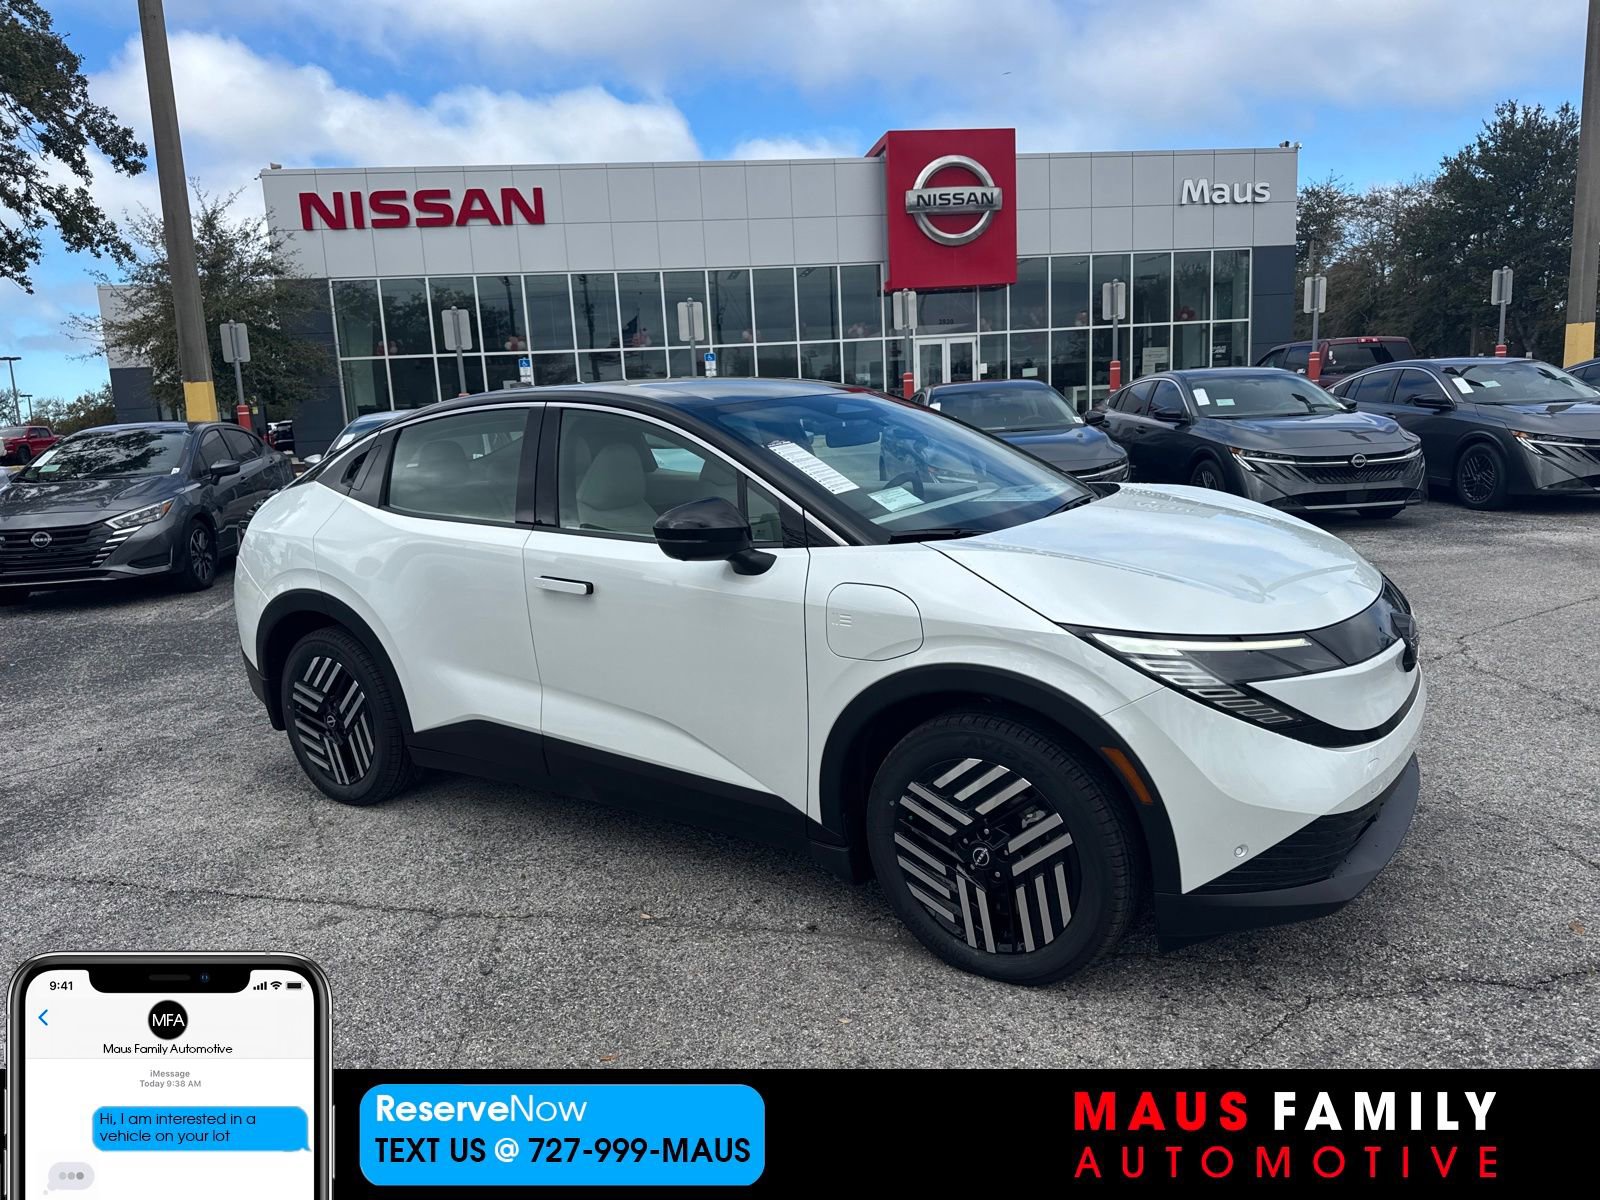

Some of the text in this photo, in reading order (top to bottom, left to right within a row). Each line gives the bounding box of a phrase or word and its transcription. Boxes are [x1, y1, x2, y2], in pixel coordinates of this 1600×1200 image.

[916, 192, 994, 207] NISSAN
[1181, 179, 1271, 204] Maus
[300, 187, 545, 231] NISSAN
